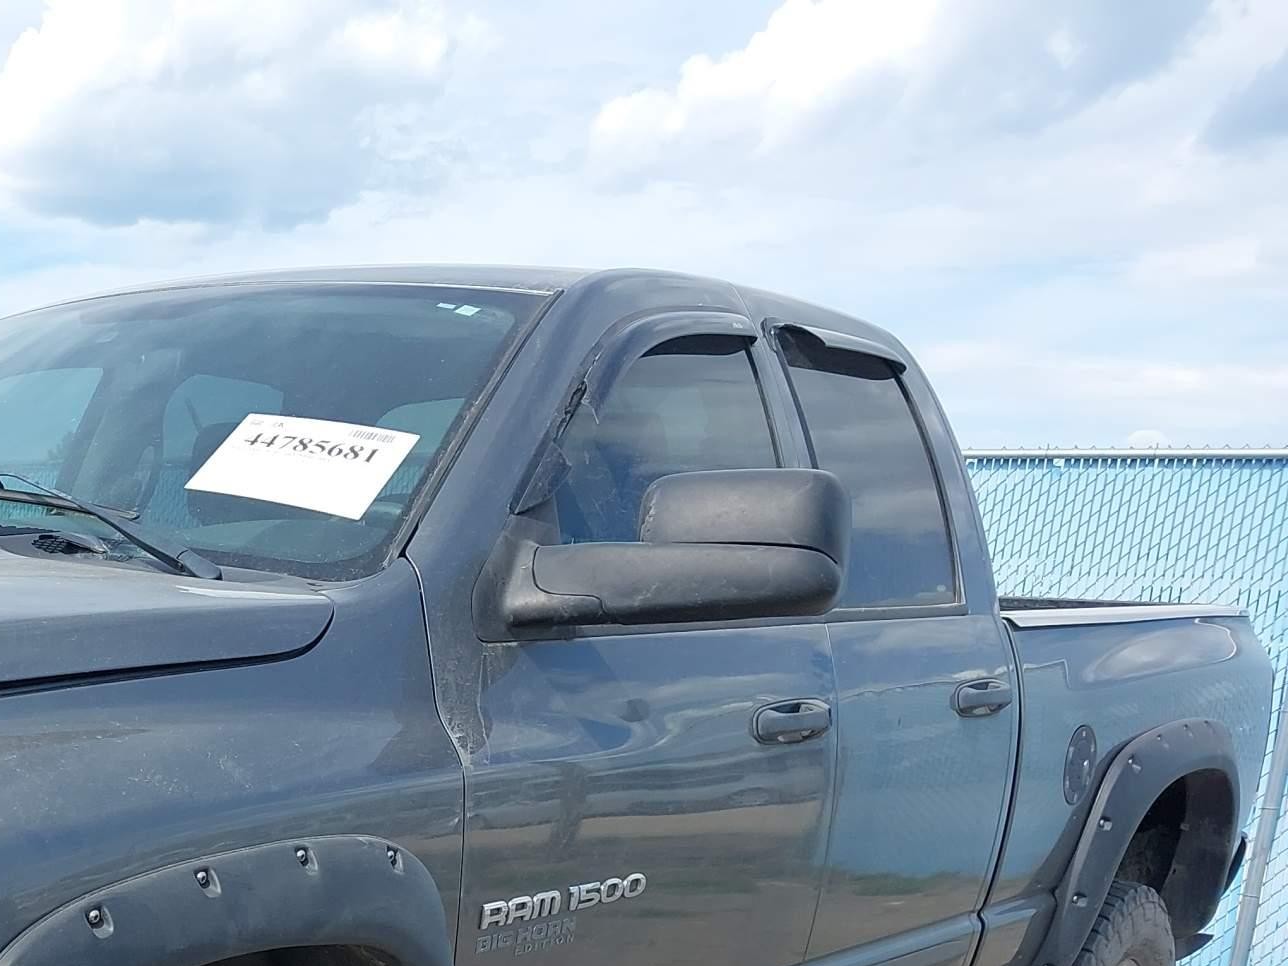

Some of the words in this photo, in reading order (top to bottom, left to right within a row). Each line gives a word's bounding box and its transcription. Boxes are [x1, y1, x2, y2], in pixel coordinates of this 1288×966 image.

[244, 432, 379, 463] 44785681
[479, 890, 561, 930] RAM
[569, 873, 647, 911] 1500
[476, 933, 513, 954] BIG
[516, 918, 576, 944] HORN
[515, 933, 575, 956] EDITION
